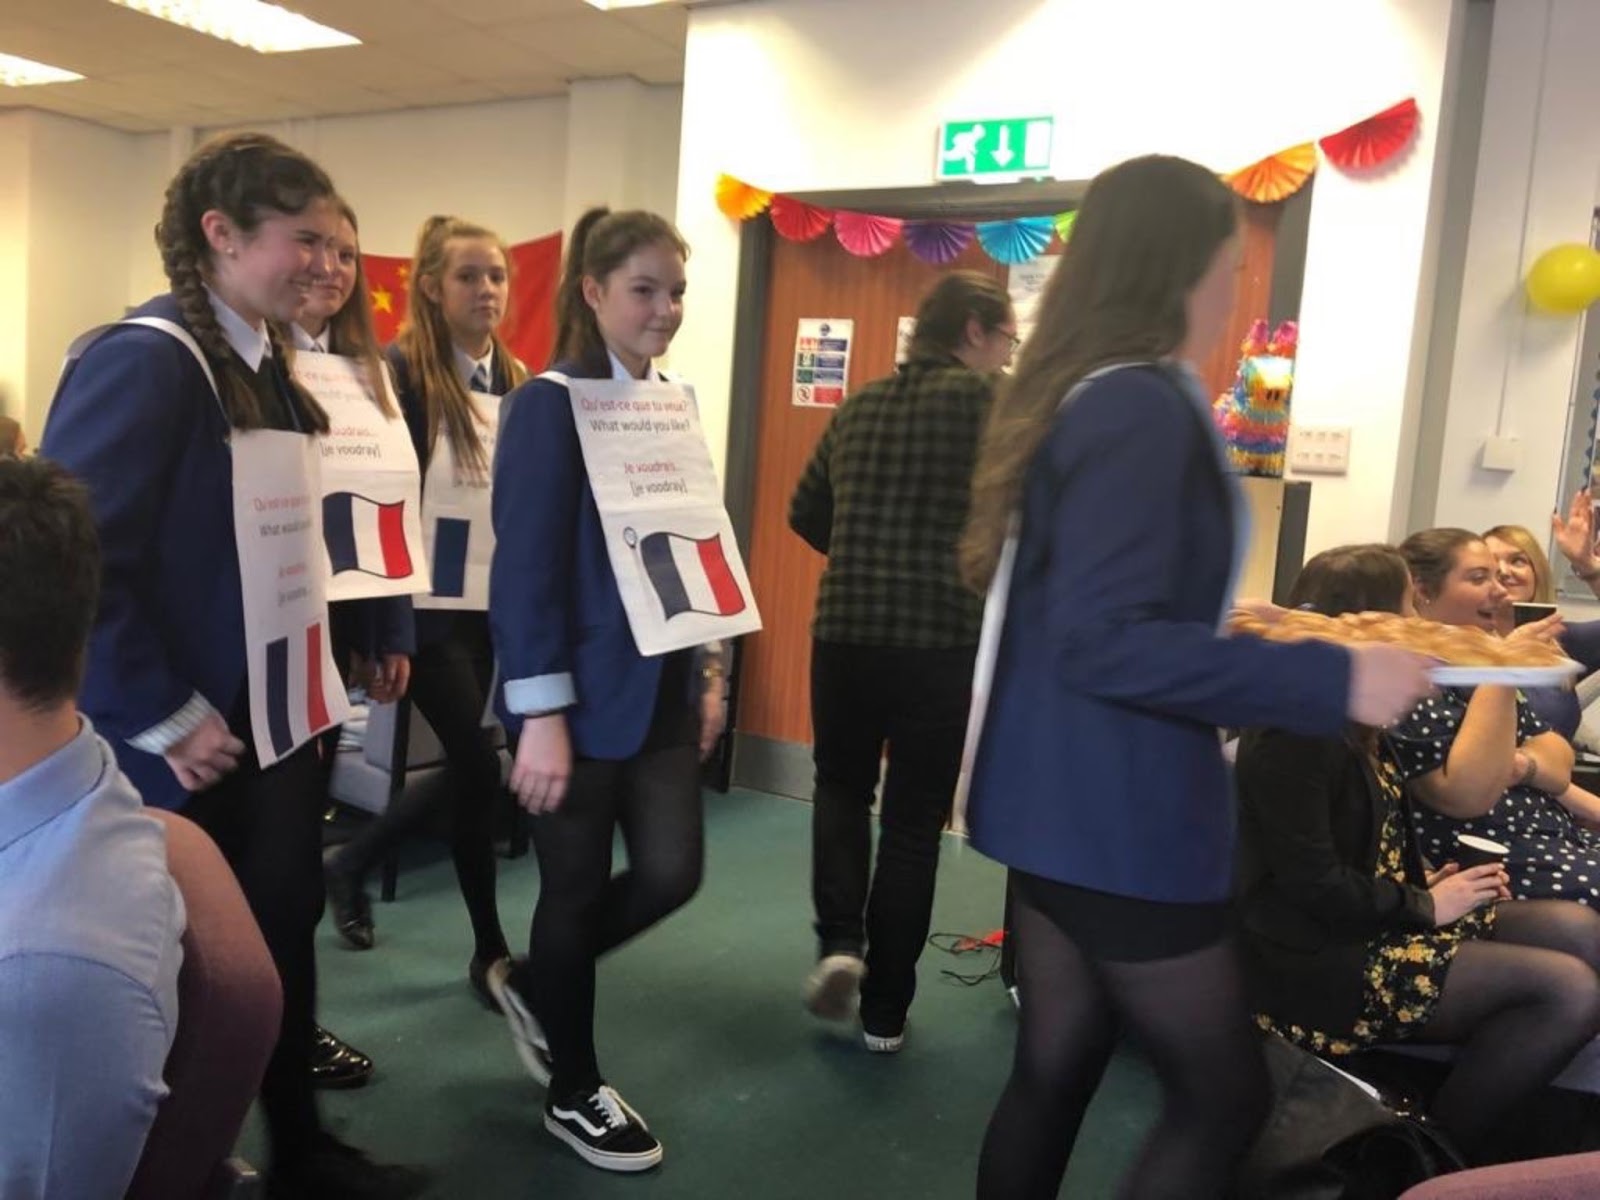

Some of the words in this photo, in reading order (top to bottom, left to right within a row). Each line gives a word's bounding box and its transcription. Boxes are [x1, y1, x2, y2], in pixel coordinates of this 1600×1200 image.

[633, 400, 652, 413] que
[590, 419, 619, 432] What
[621, 418, 652, 431] would
[654, 421, 670, 434] you
[671, 418, 690, 432] like?
